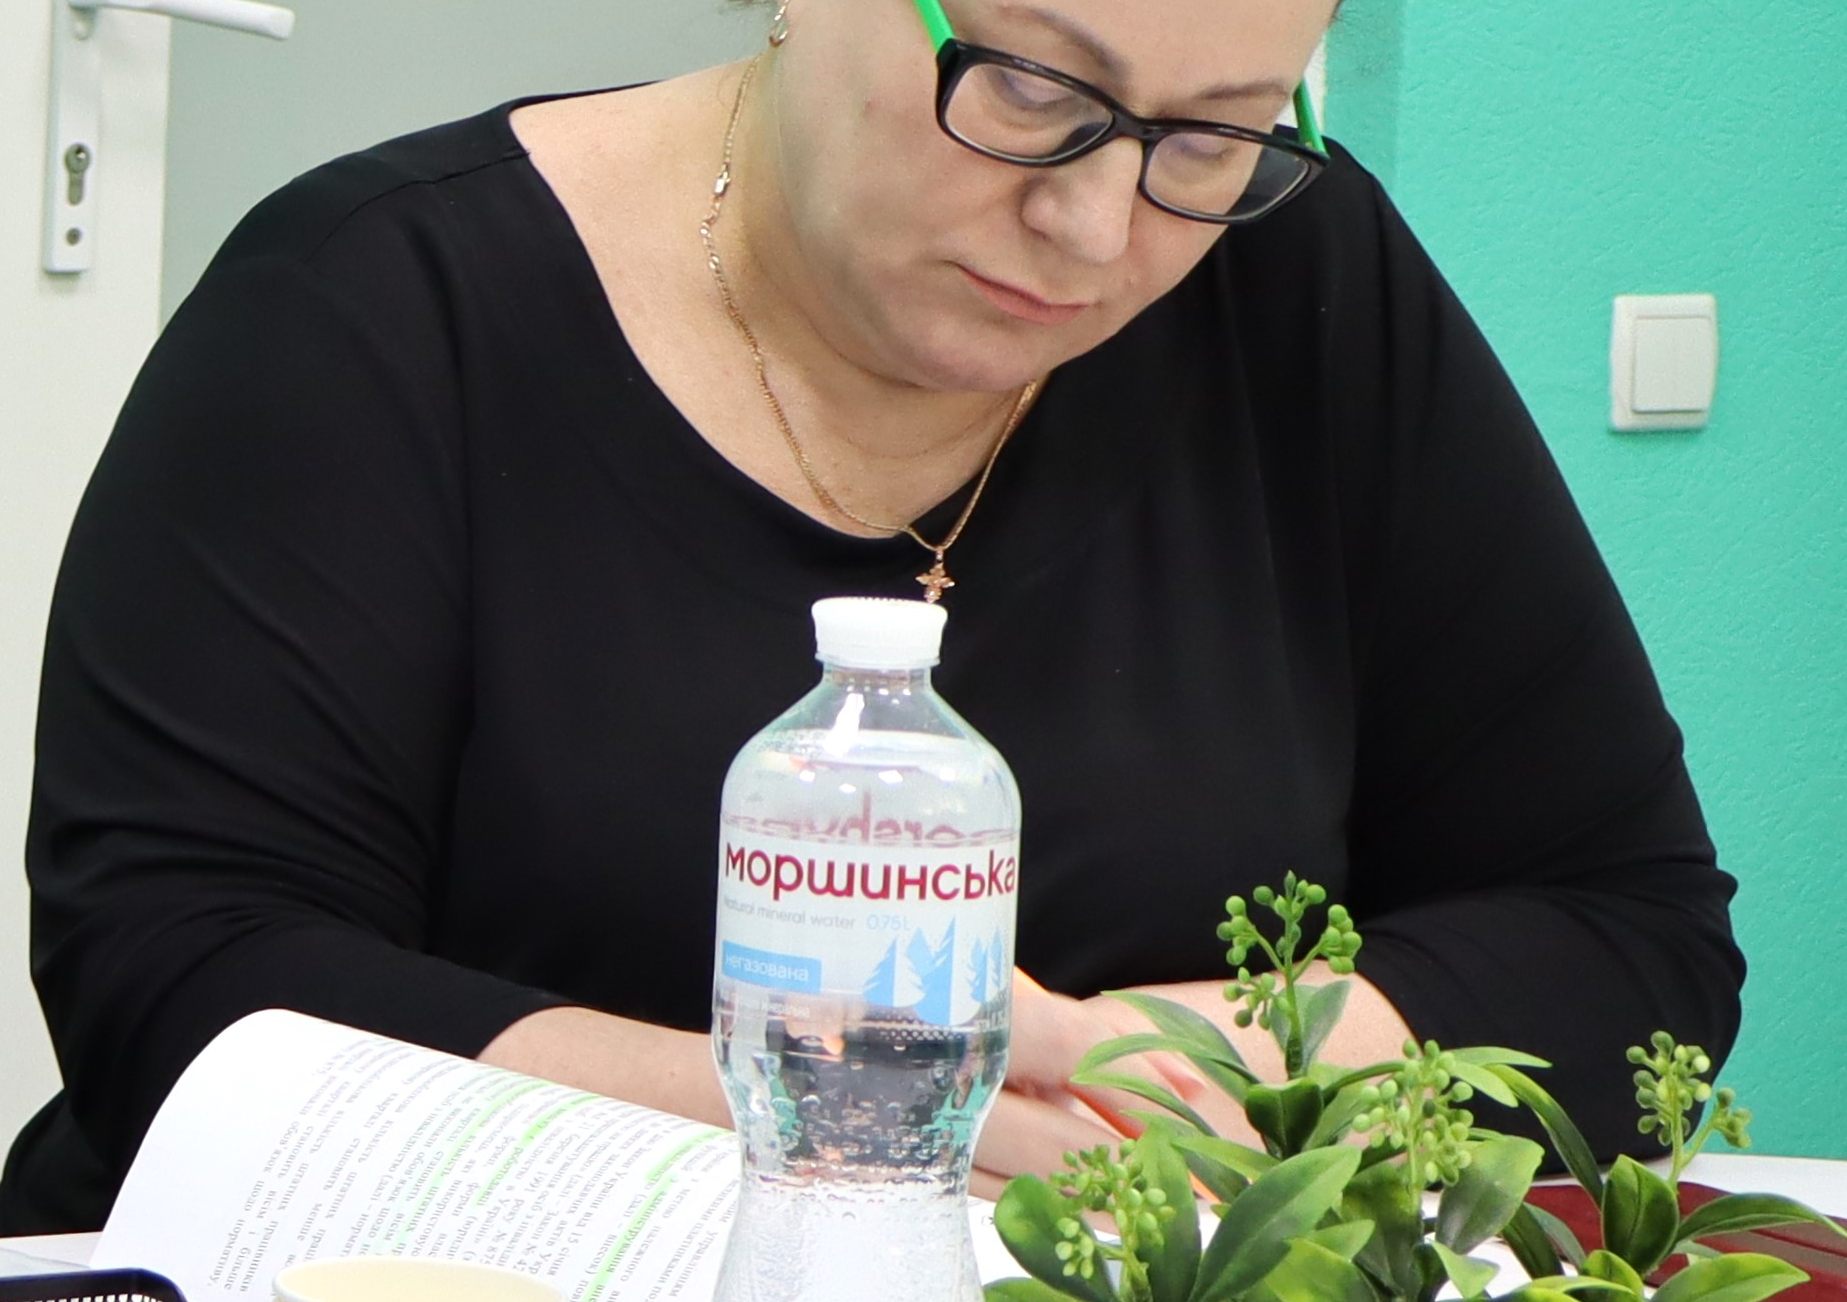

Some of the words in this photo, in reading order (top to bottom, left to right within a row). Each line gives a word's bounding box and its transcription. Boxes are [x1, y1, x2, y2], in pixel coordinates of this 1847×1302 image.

[725, 842, 1016, 901] моршинська
[757, 907, 806, 926] mineral
[811, 913, 855, 929] water
[725, 952, 809, 983] негазована
[276, 1123, 315, 1182] становить
[241, 1178, 267, 1213] щодо
[254, 1189, 278, 1220] вісім
[275, 1161, 310, 1213] штатних
[404, 1183, 440, 1236] штатних
[382, 1211, 407, 1243] вісім
[619, 1222, 661, 1284] належного
[218, 1244, 253, 1291] більше
[231, 1218, 284, 1295] працівників
[667, 1226, 718, 1301] управлінням
